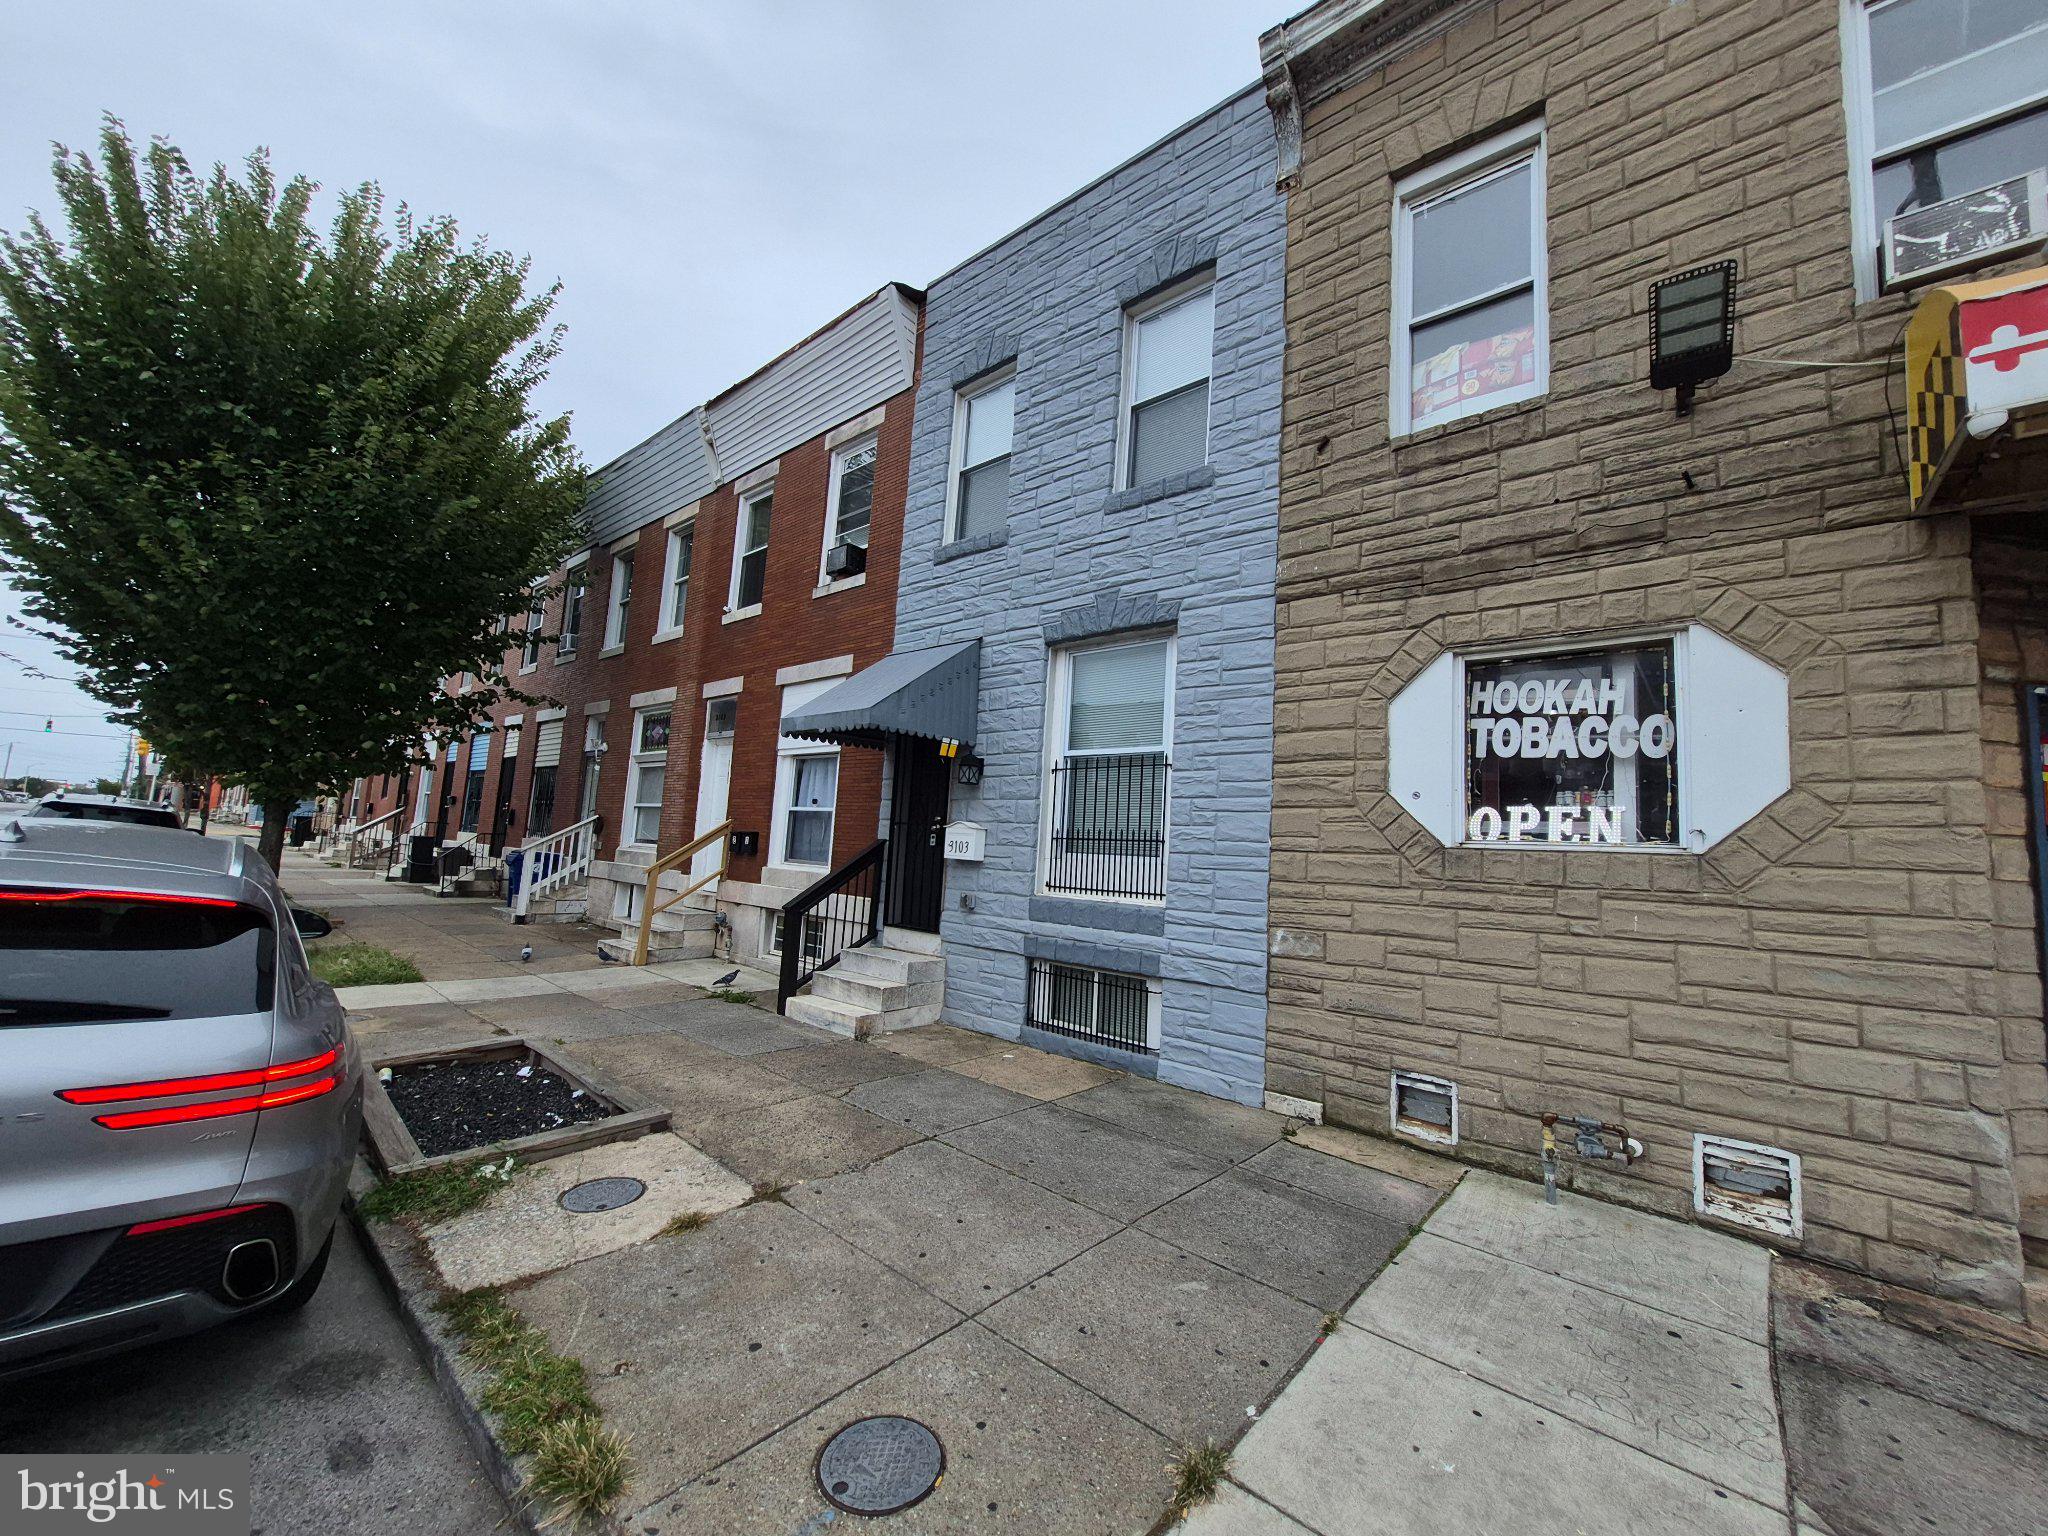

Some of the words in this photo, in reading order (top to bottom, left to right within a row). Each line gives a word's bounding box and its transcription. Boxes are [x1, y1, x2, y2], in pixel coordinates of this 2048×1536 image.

[1470, 678, 1626, 715] HOOKAH
[1470, 714, 1675, 759] TOBACCO
[1469, 805, 1627, 844] OPEN
